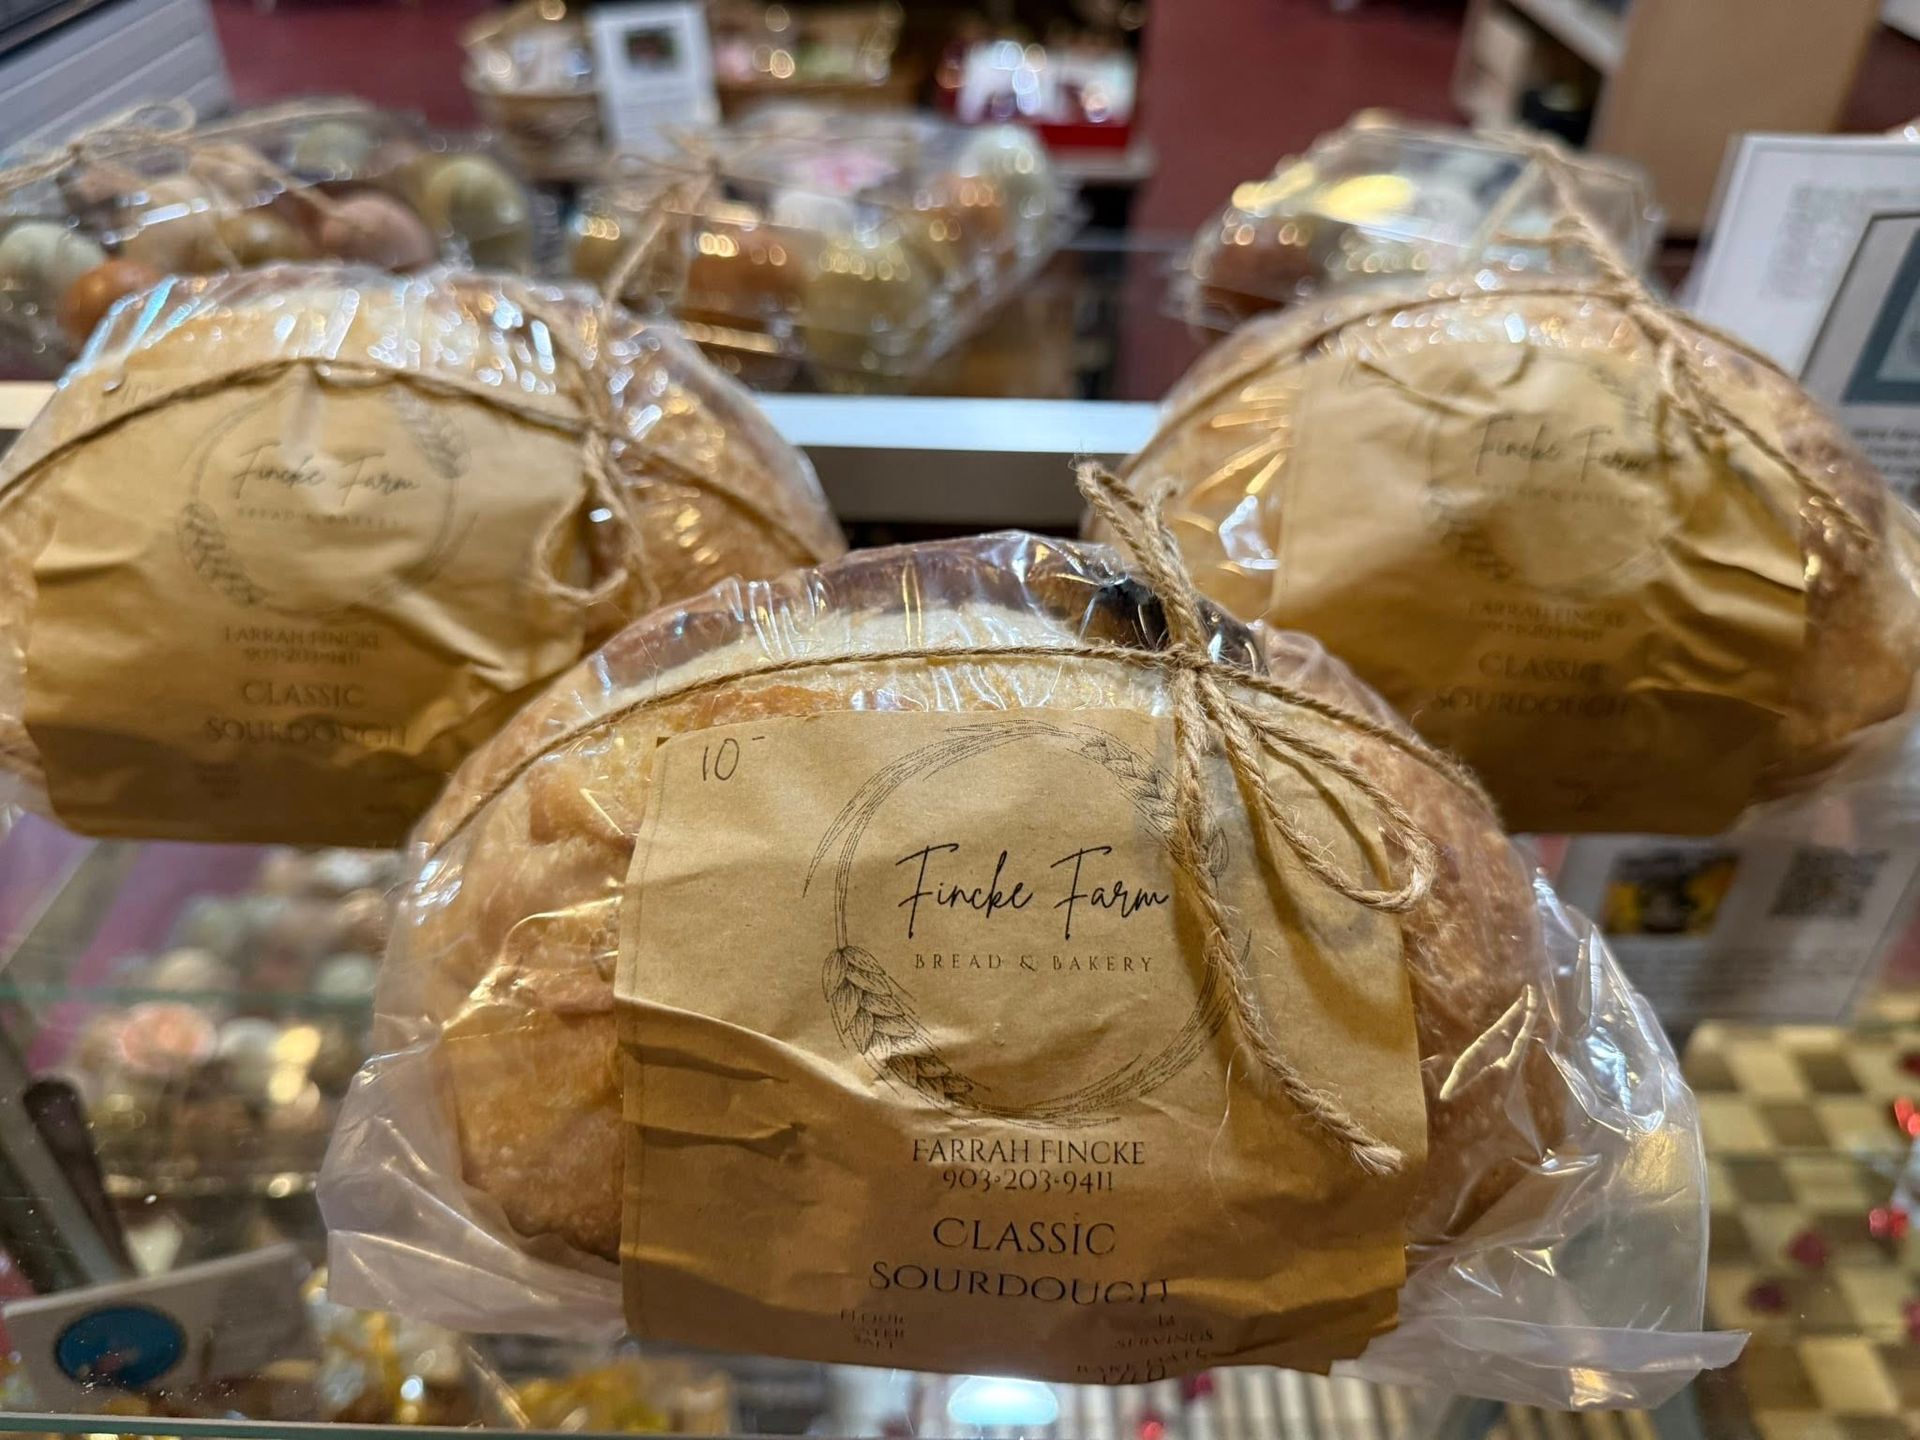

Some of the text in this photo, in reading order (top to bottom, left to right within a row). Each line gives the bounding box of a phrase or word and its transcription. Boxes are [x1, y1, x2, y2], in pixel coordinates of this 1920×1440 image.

[895, 843, 1171, 941] Fincke Farm
[912, 952, 1153, 973] BREAD & BAKERY
[912, 1138, 1146, 1166] FARRAH FINCKE
[932, 1216, 1117, 1257] CLASSIC
[868, 1260, 1169, 1306] SOURDOUGH
